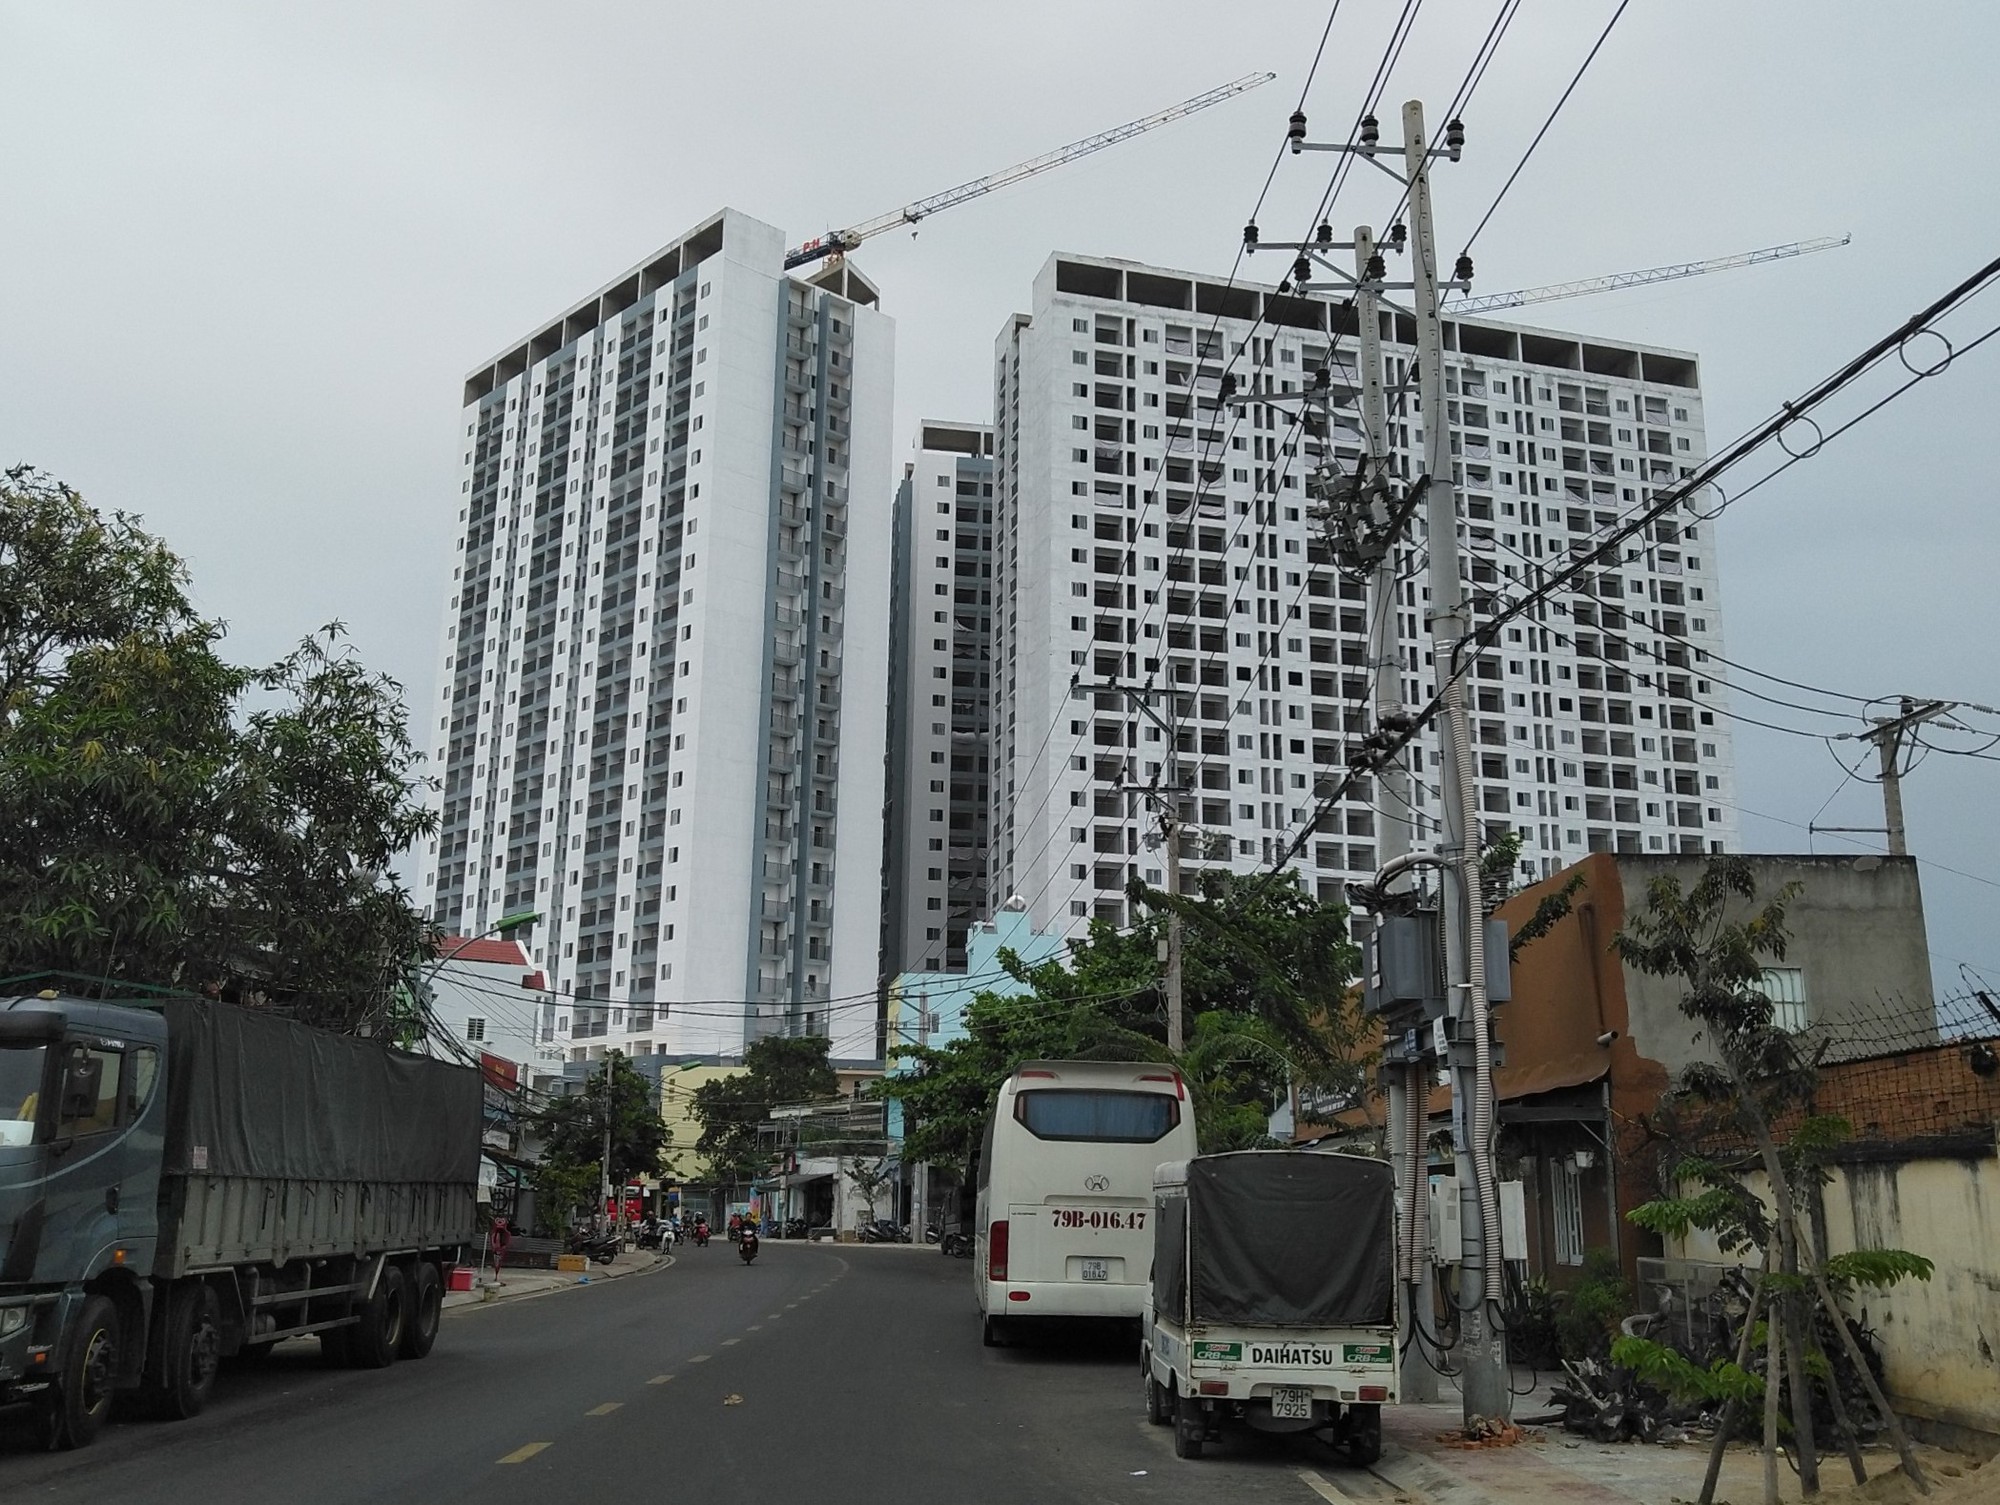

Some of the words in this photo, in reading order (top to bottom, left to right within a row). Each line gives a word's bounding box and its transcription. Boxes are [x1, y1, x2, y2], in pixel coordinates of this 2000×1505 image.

[1052, 1209, 1147, 1230] 79B-016.47
[1197, 1351, 1221, 1359] CRB
[1252, 1348, 1333, 1365] DAIHATSU
[1347, 1354, 1371, 1362] CRB
[1281, 1390, 1303, 1403] 79H
[1276, 1402, 1308, 1416] 7925
